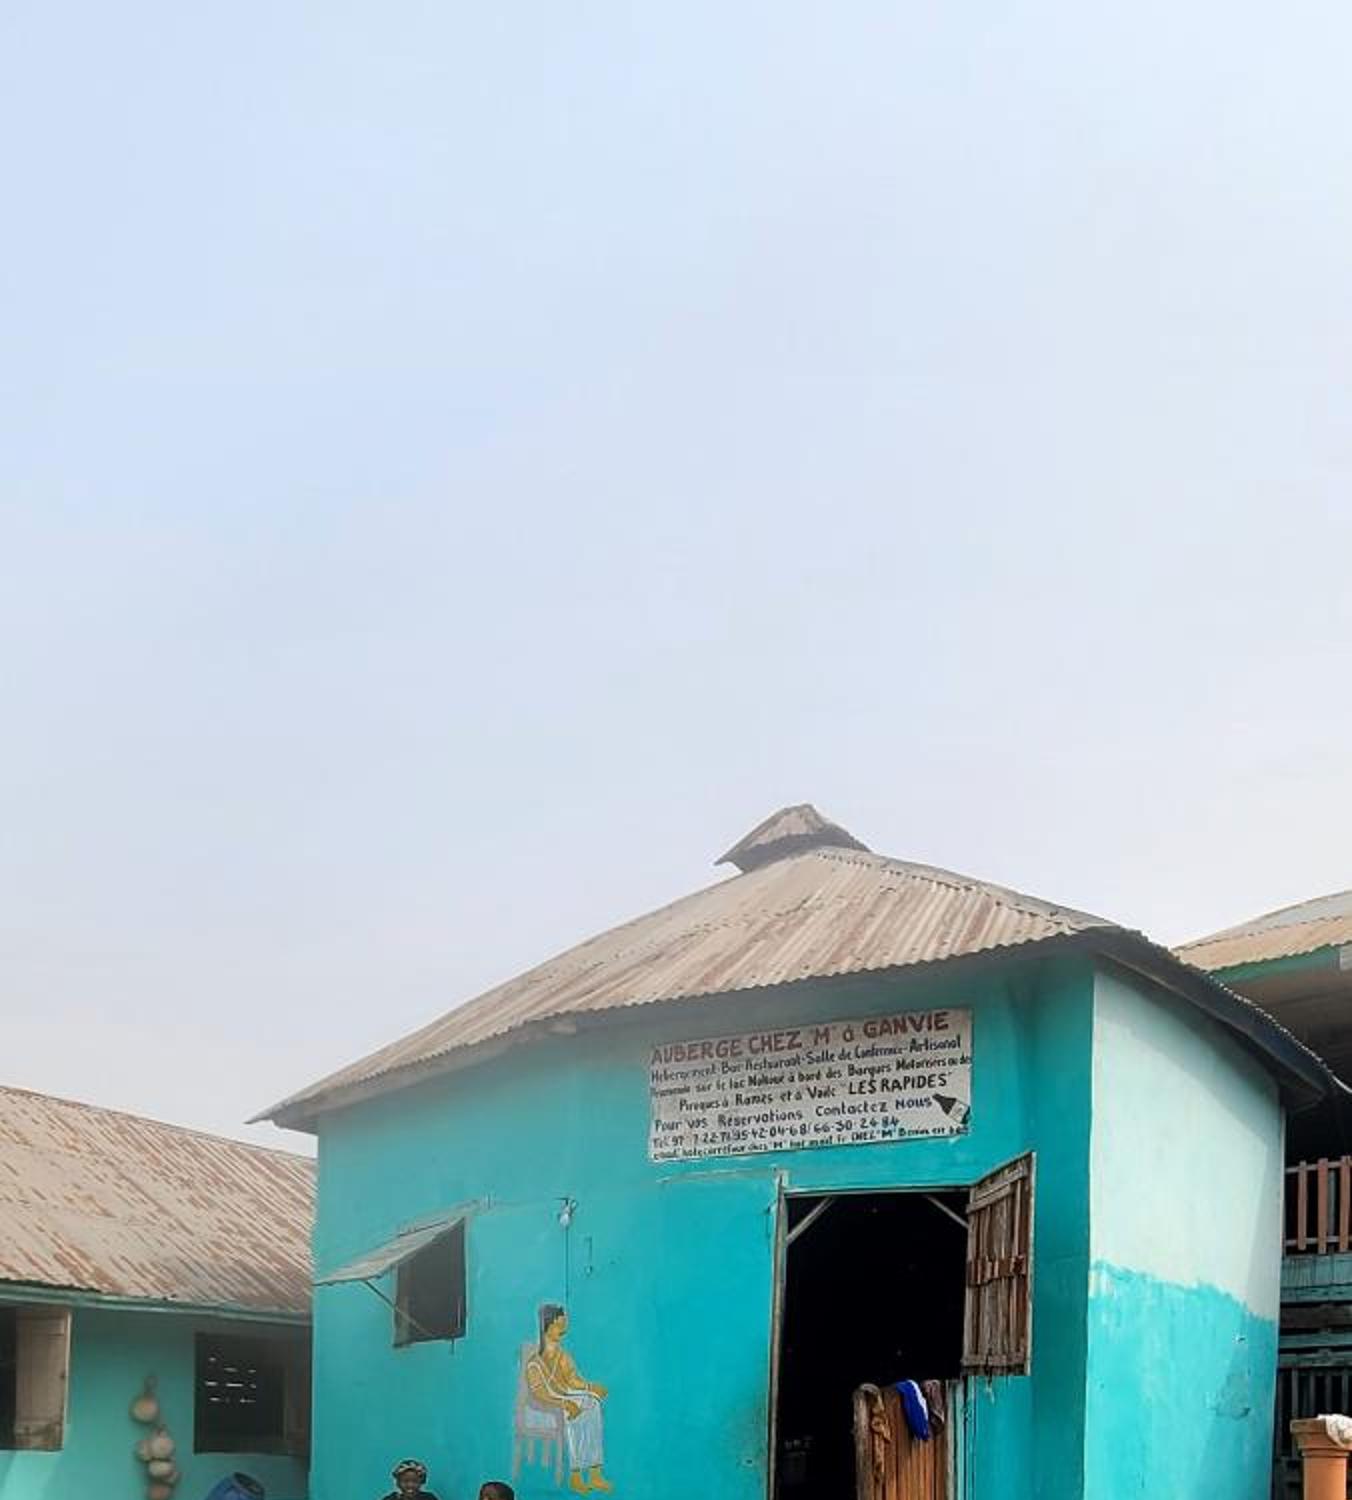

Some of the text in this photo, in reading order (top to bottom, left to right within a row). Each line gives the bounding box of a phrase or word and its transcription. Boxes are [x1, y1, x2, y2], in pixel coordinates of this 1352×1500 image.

[651, 1039, 742, 1064] AUBERGE
[749, 1030, 802, 1055] CHEZ
[863, 1011, 949, 1038] GANVIE
[825, 1066, 842, 1079] des
[655, 1118, 682, 1132] Pour
